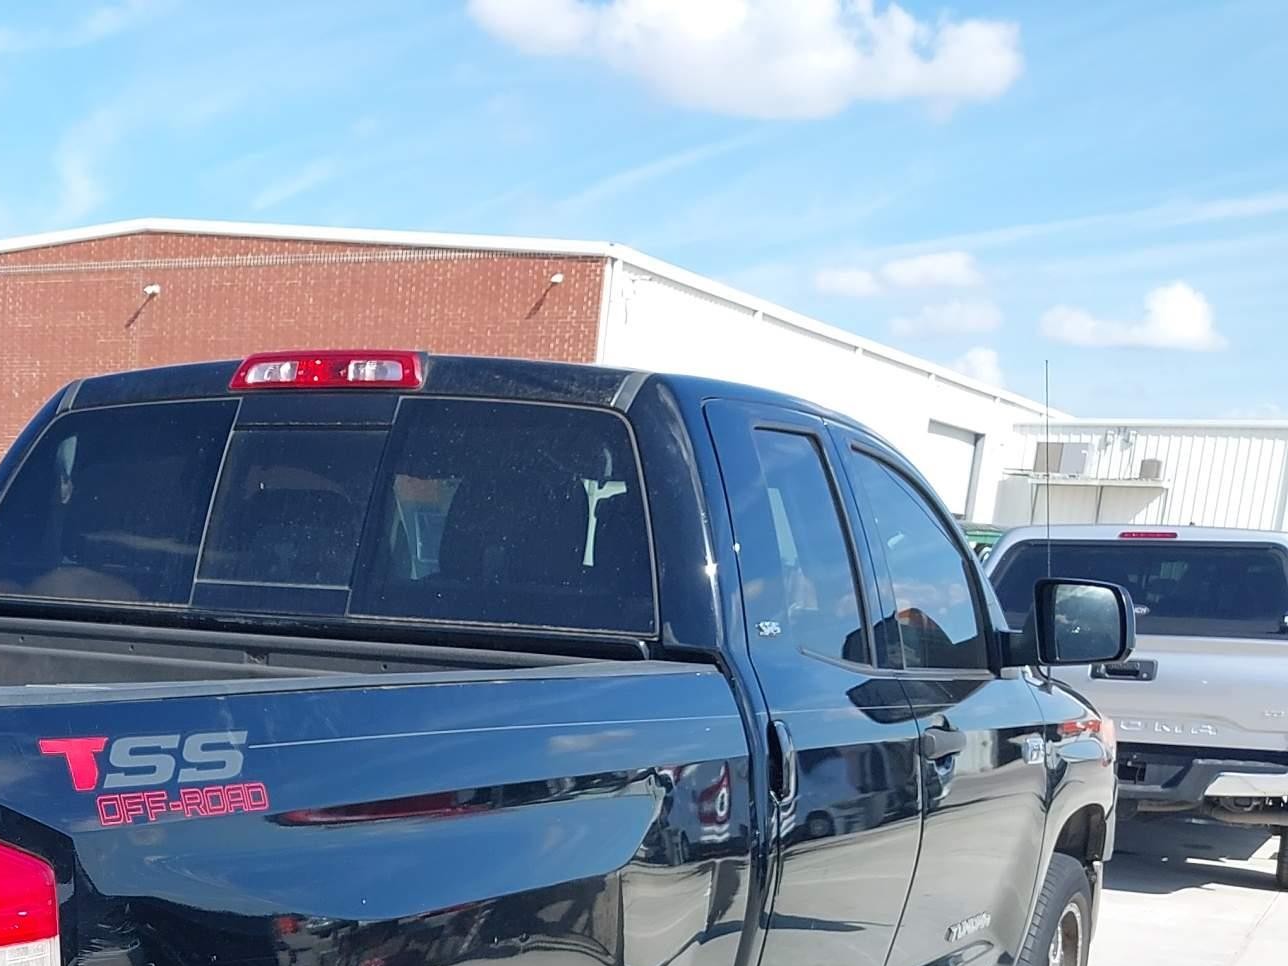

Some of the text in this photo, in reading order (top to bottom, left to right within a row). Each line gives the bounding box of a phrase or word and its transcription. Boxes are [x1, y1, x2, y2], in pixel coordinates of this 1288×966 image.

[38, 730, 249, 792] TSS
[96, 782, 269, 827] OFF-ROAD
[944, 911, 992, 943] TUNDRA
